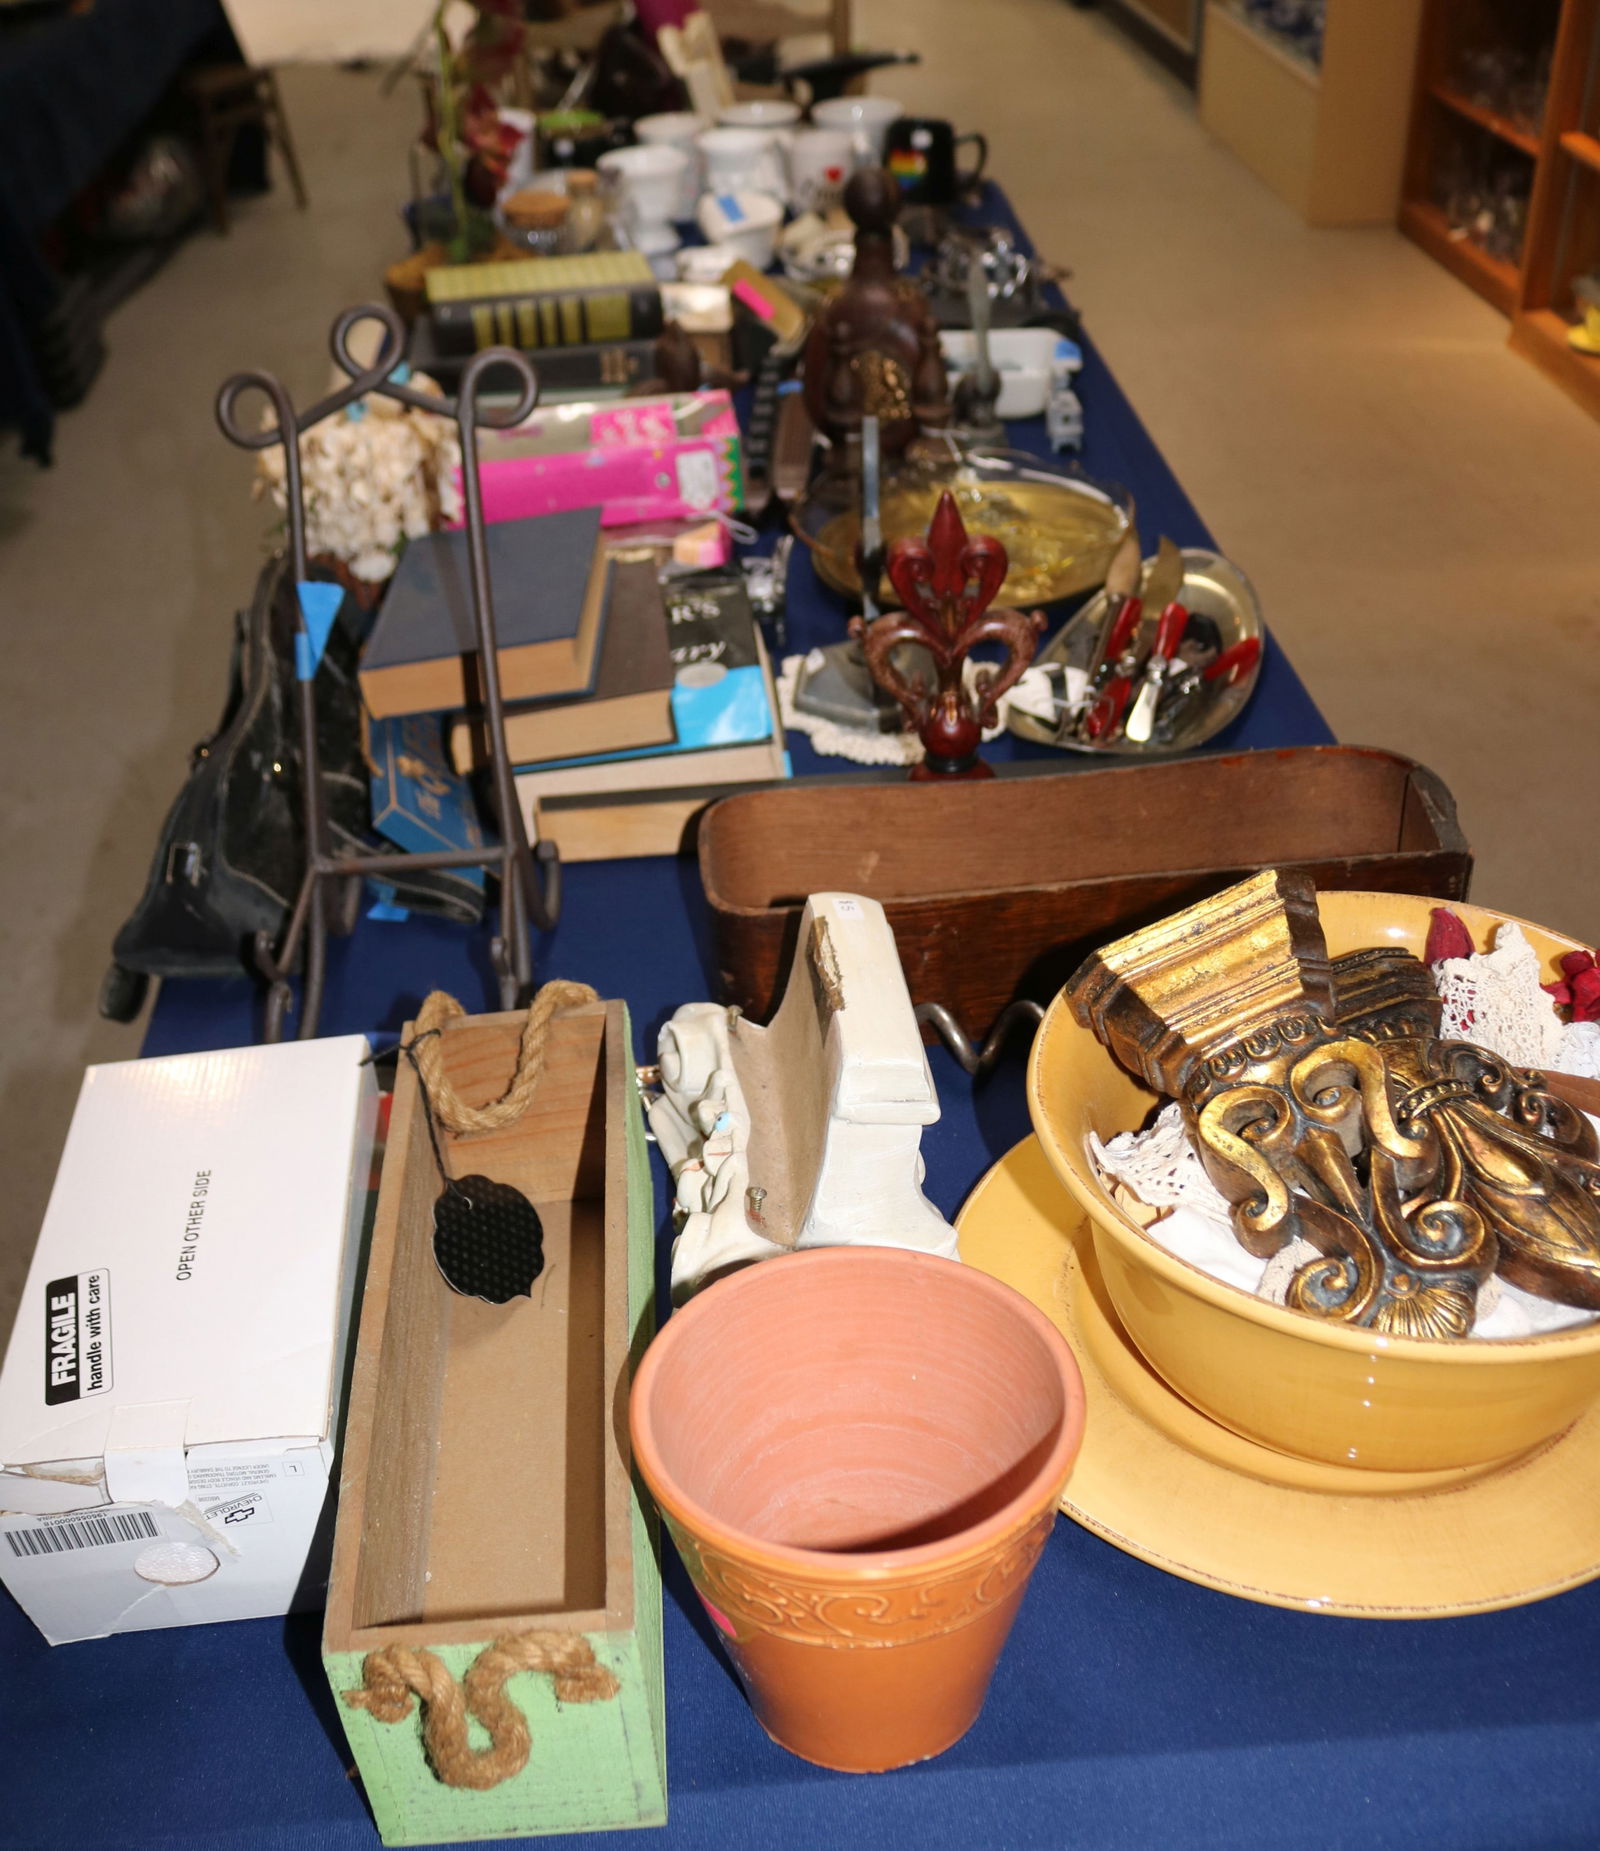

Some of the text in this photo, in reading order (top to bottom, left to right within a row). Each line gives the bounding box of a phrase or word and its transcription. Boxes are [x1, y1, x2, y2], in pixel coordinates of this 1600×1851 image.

[176, 1169, 212, 1281] OPEN OTHER SIDE
[51, 1292, 77, 1386] FRAGILE
[85, 1275, 103, 1391] handle with care
[206, 1495, 262, 1519] CHEVROLET
